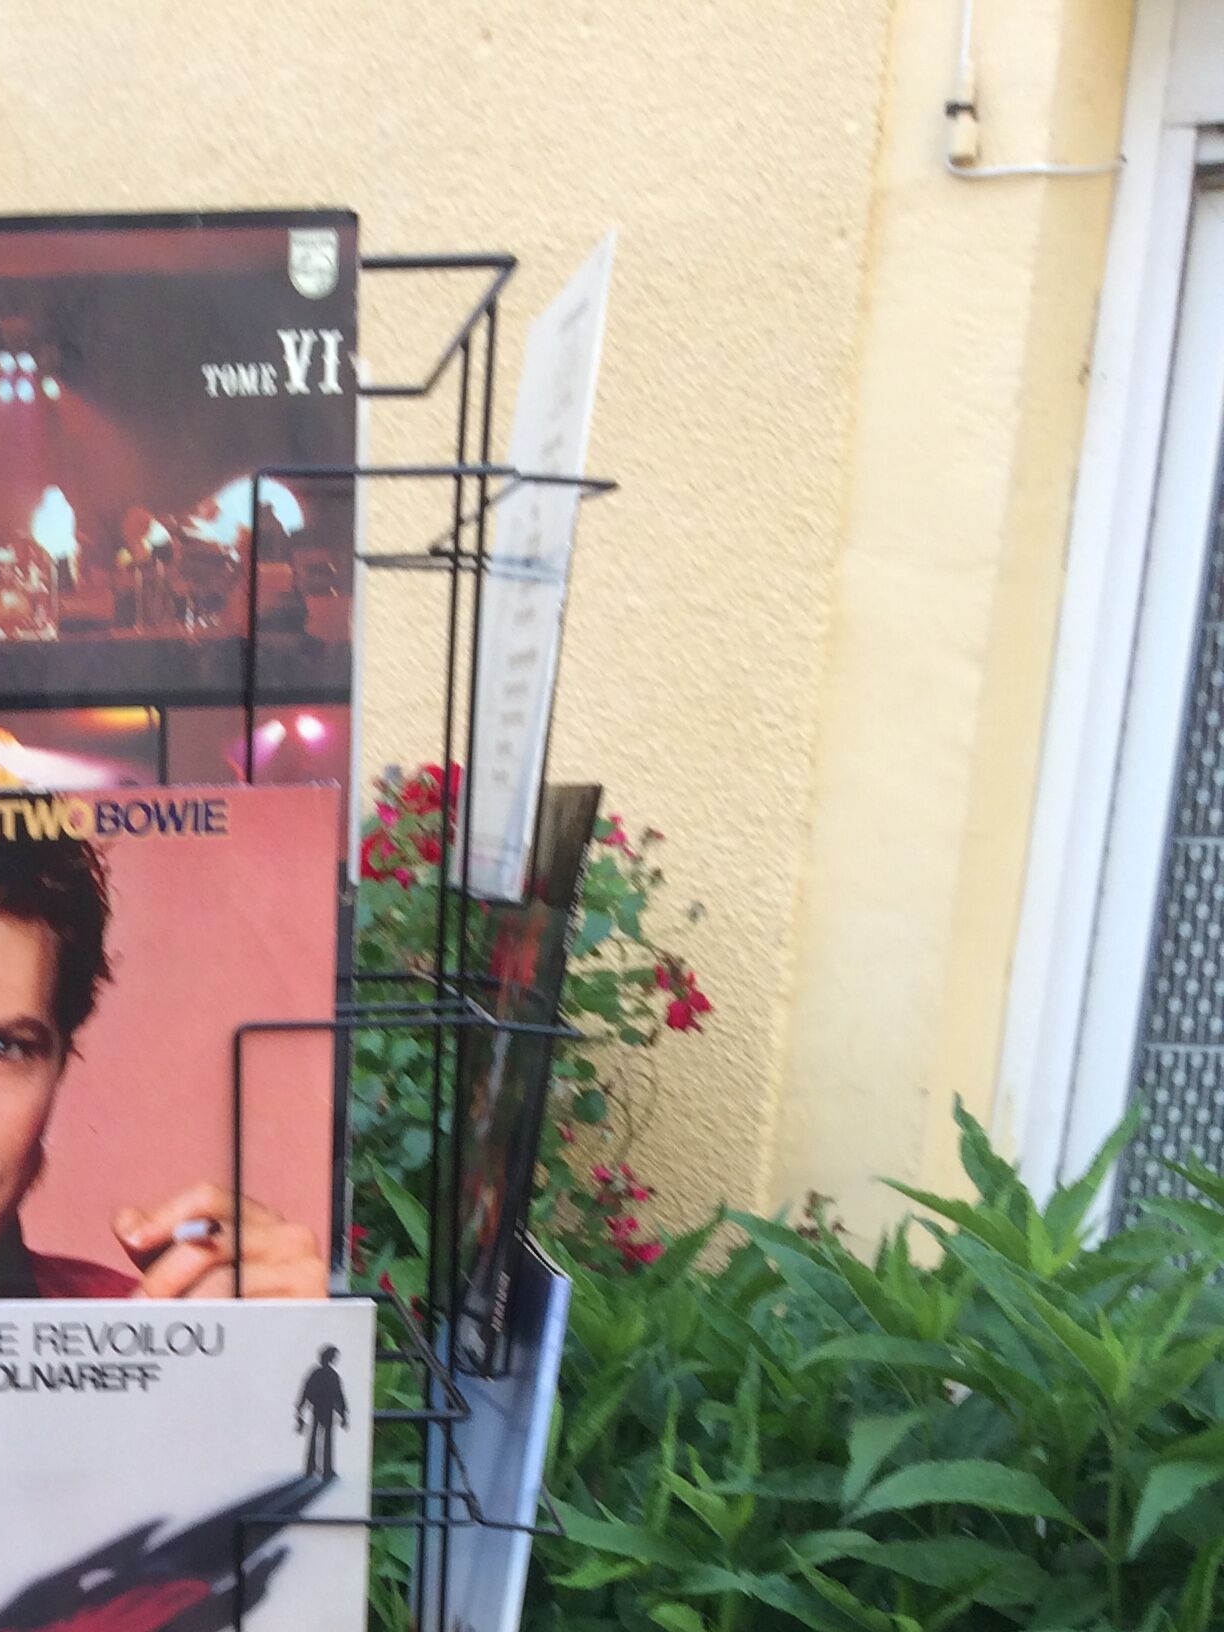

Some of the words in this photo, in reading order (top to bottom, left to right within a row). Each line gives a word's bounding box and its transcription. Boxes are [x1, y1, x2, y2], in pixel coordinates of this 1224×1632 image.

[200, 361, 278, 398] TOME
[276, 328, 344, 395] VI
[32, 1320, 226, 1357] REVOILOU
